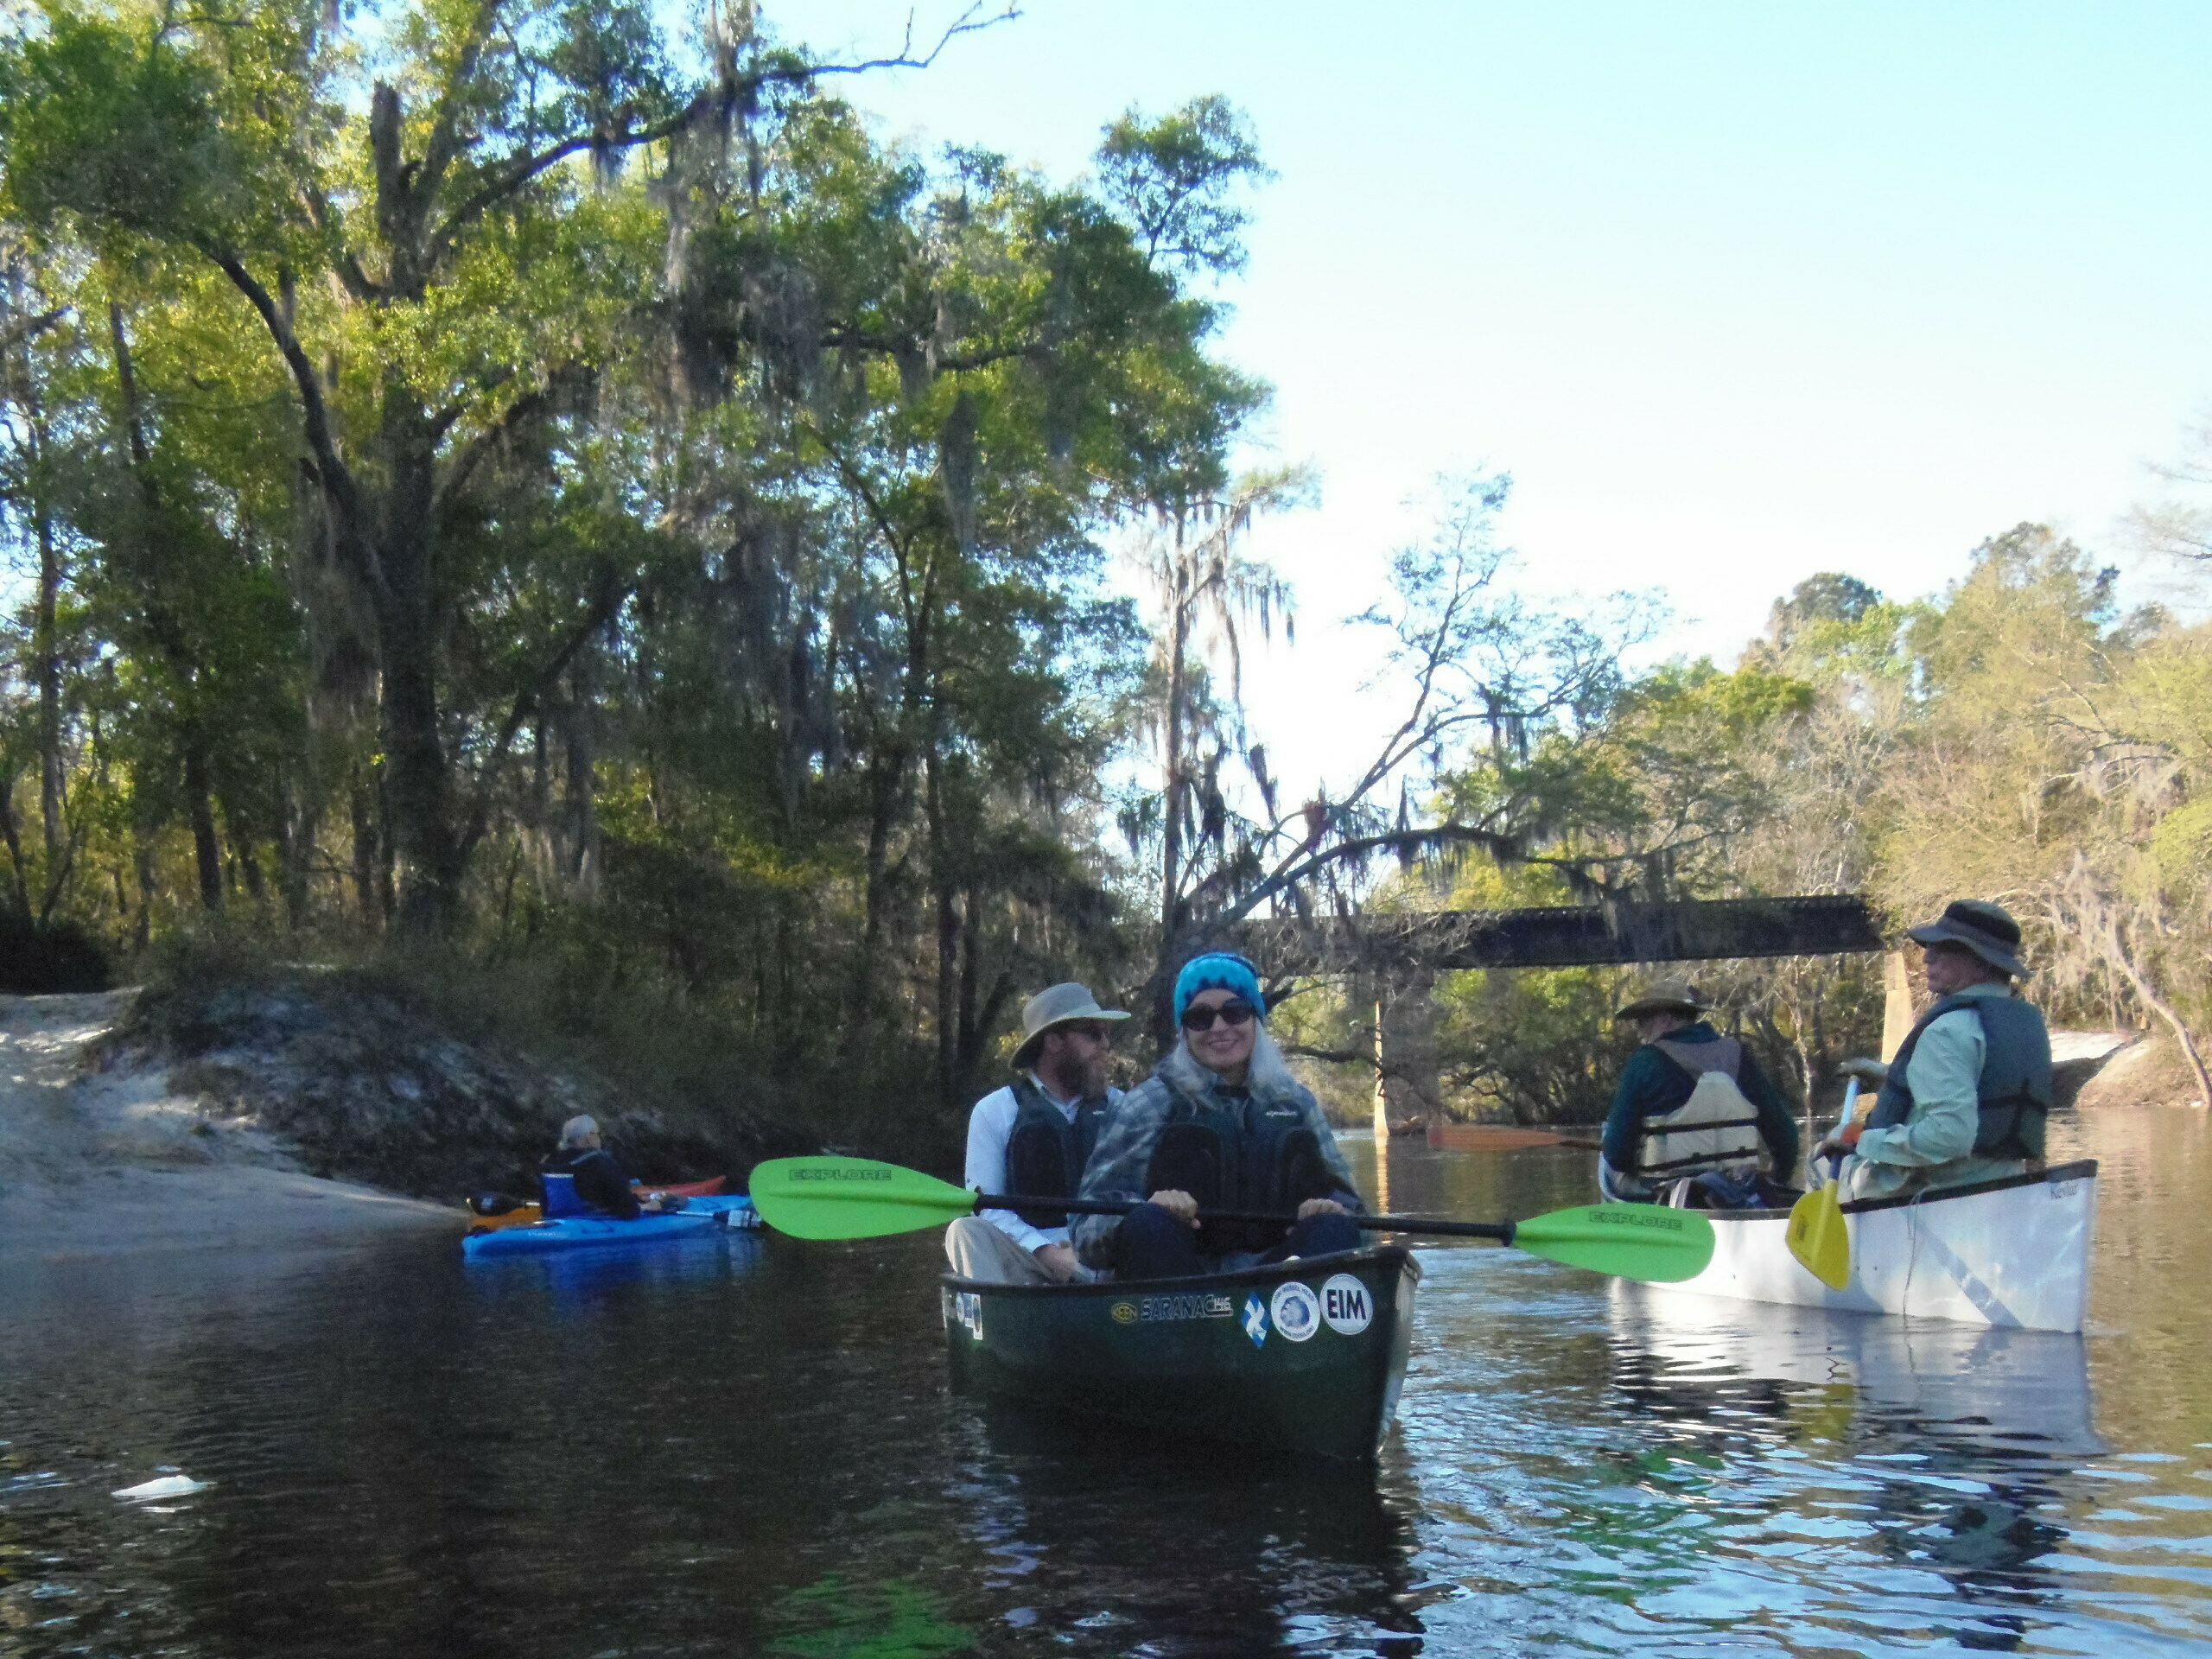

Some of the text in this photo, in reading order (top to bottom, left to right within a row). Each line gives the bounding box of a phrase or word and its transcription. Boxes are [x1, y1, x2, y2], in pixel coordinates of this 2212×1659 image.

[789, 1169, 892, 1181] EXPLORE
[1589, 1211, 1682, 1230] EXPLORE
[1141, 1294, 1215, 1320] SARANAC
[1326, 1288, 1367, 1320] EIM
